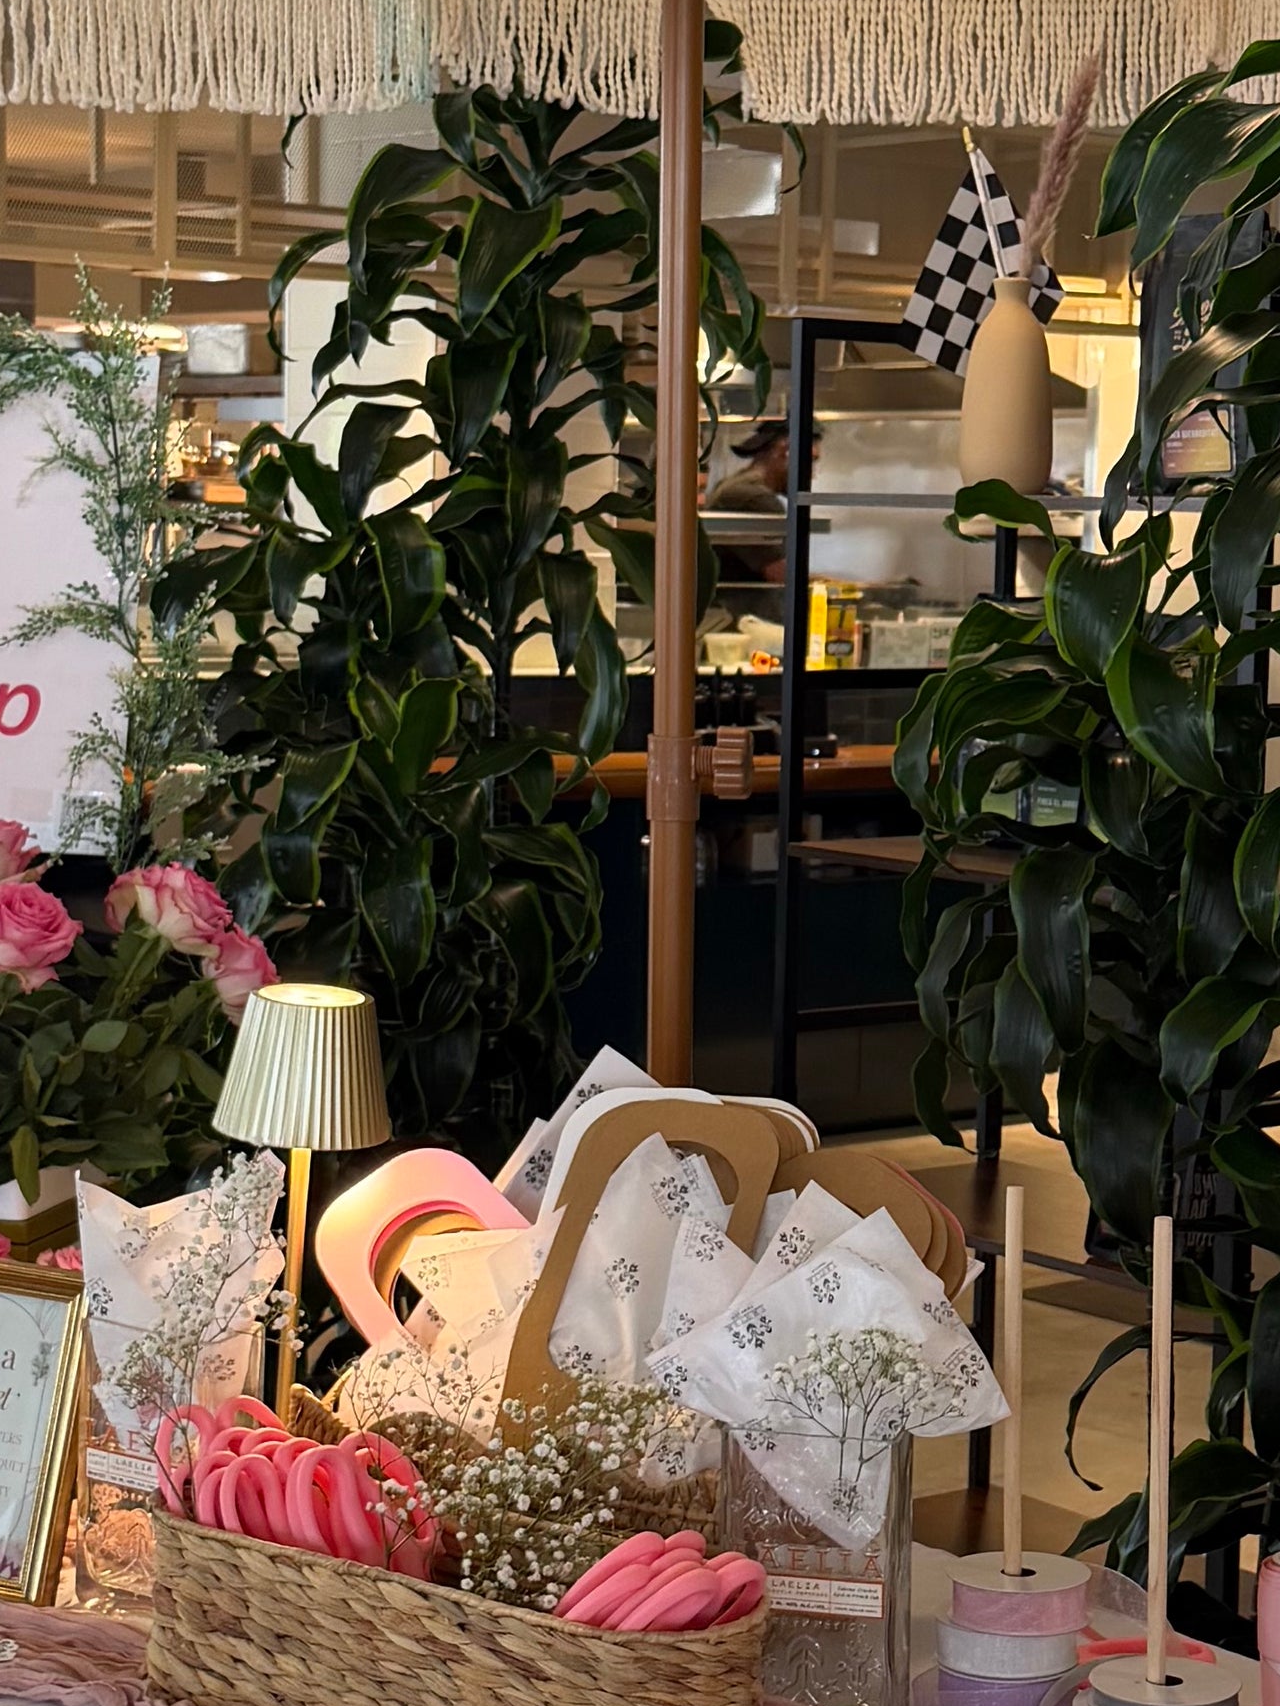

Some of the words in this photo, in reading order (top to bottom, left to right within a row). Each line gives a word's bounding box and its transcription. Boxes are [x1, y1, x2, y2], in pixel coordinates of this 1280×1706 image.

[1, 1348, 17, 1371] a
[758, 1543, 883, 1579] AELIA
[771, 1578, 821, 1591] LAELIA
